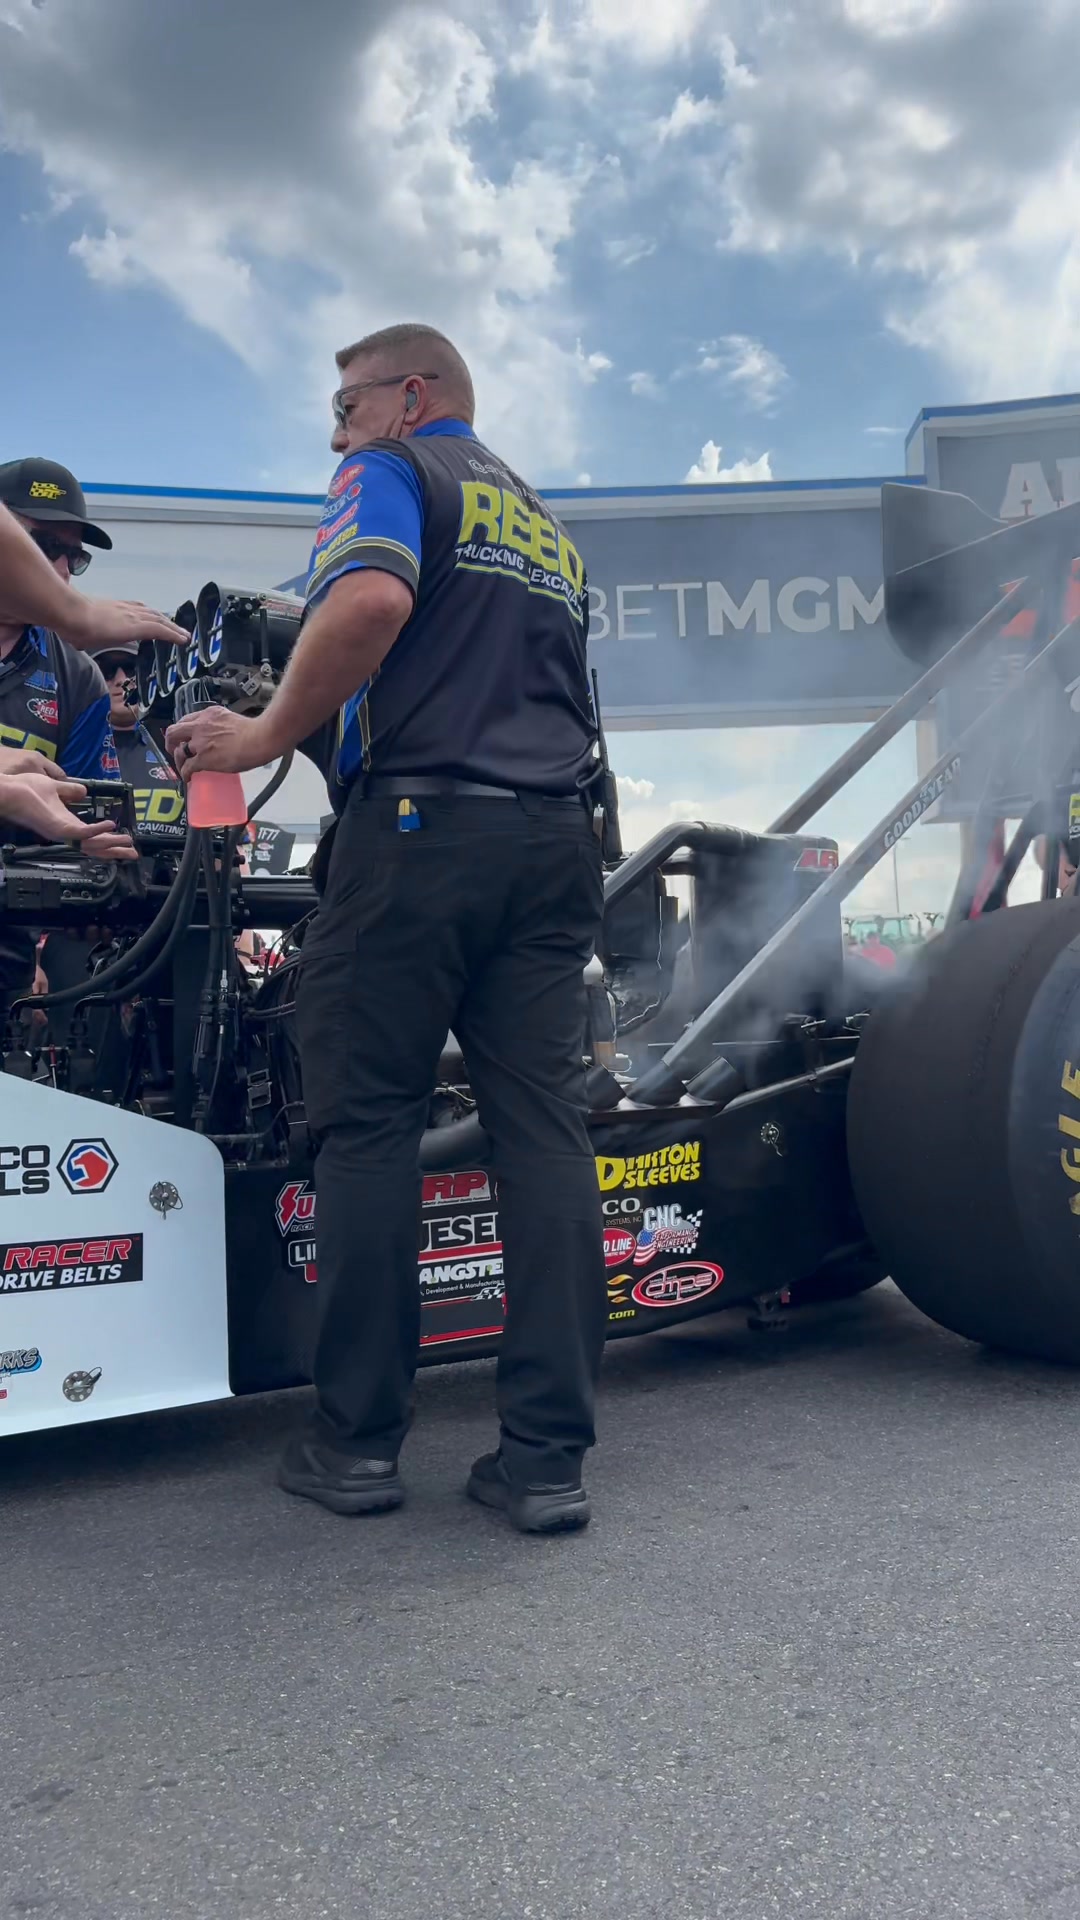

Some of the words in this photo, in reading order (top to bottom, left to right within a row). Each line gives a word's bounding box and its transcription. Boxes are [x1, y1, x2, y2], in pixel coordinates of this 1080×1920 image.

[458, 481, 584, 596] REED
[455, 543, 525, 570] TRUCKING
[136, 822, 186, 836] CAVATING
[623, 1162, 701, 1190] SLEEVES
[642, 1203, 682, 1233] CNC
[611, 1237, 633, 1252] LINE
[651, 1237, 696, 1250] ENGINEERING
[652, 1228, 698, 1241] PERFORMANCE
[3, 1238, 132, 1271] RACER
[60, 1264, 122, 1285] BELTS
[425, 1284, 459, 1295] Development
